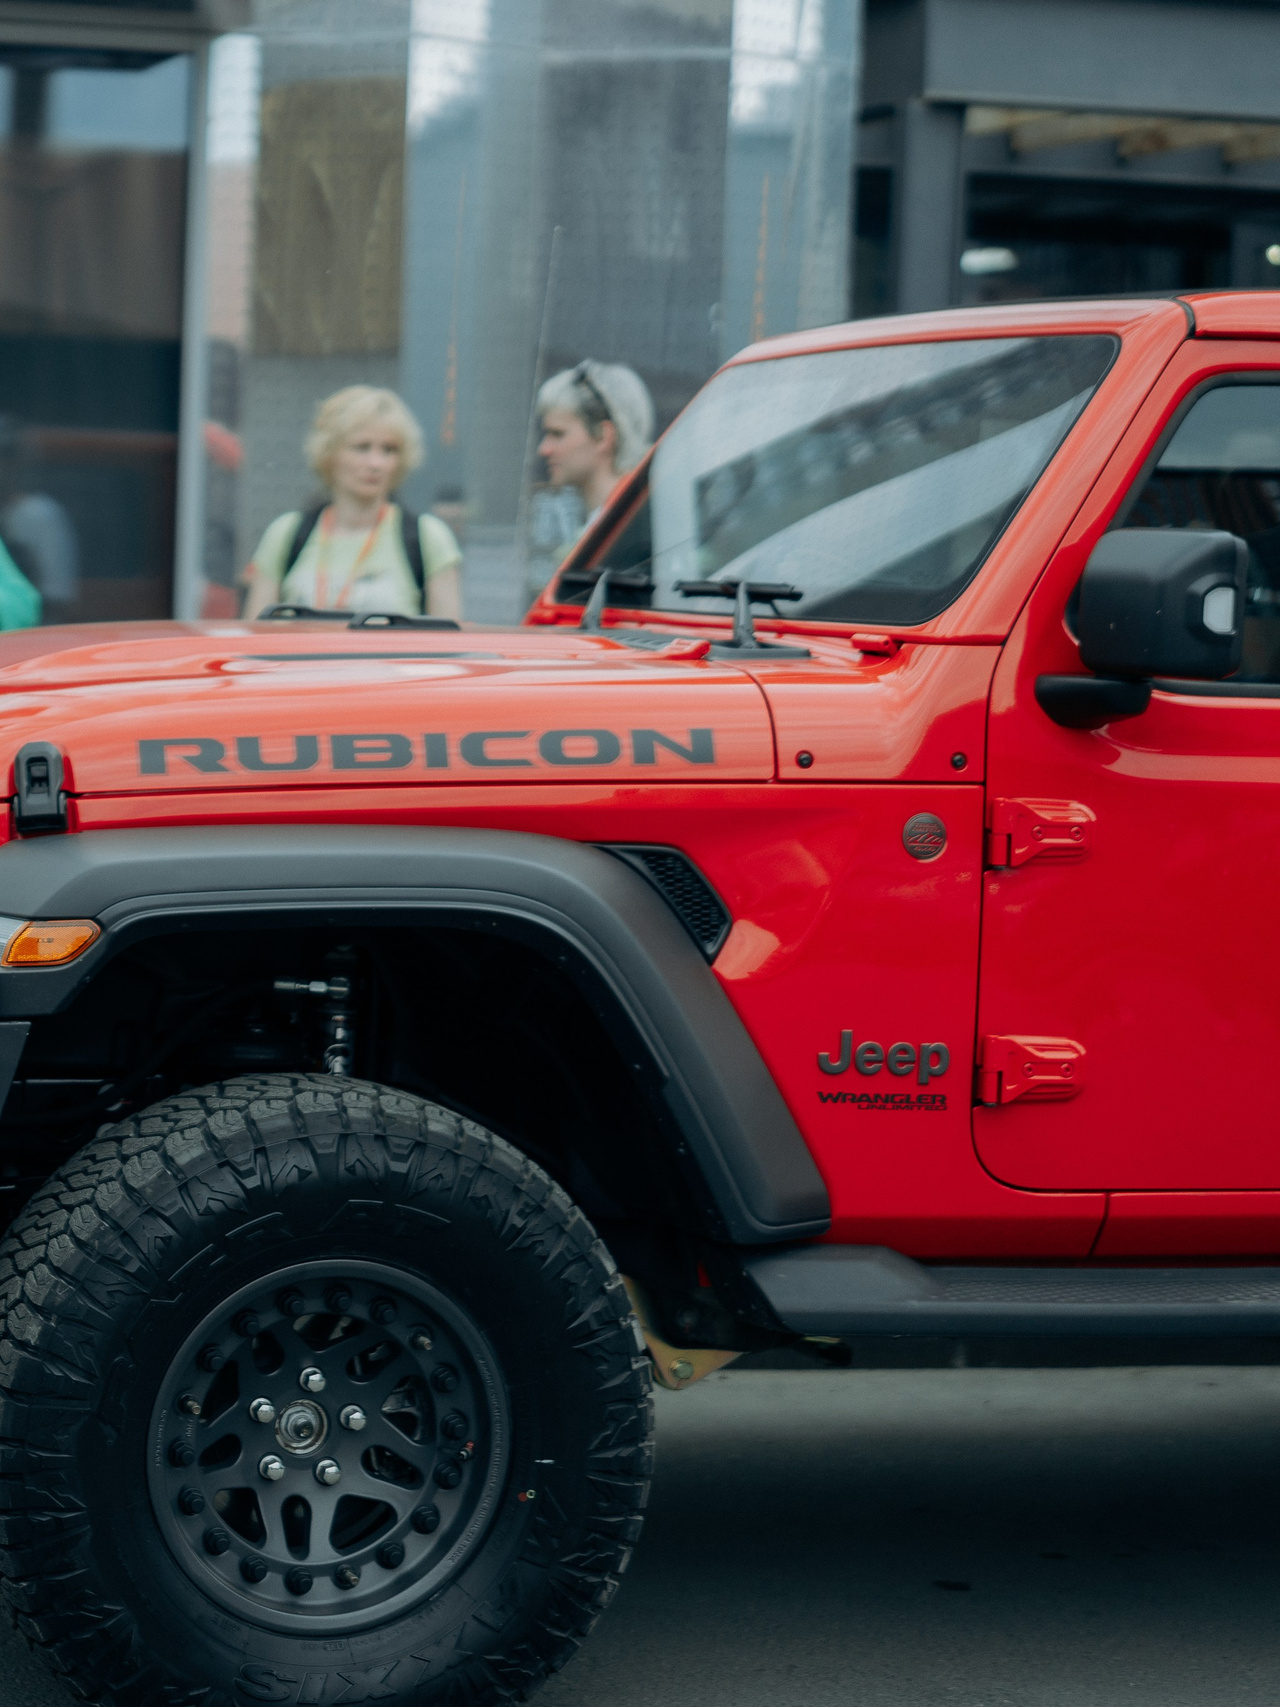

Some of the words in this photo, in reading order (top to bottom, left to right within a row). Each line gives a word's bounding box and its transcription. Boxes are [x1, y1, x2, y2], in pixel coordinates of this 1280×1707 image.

[137, 727, 716, 776] RUBICON
[817, 1029, 951, 1085] Jeep
[816, 1091, 948, 1105] WRANGLER
[856, 1104, 948, 1112] UNLIMITED
